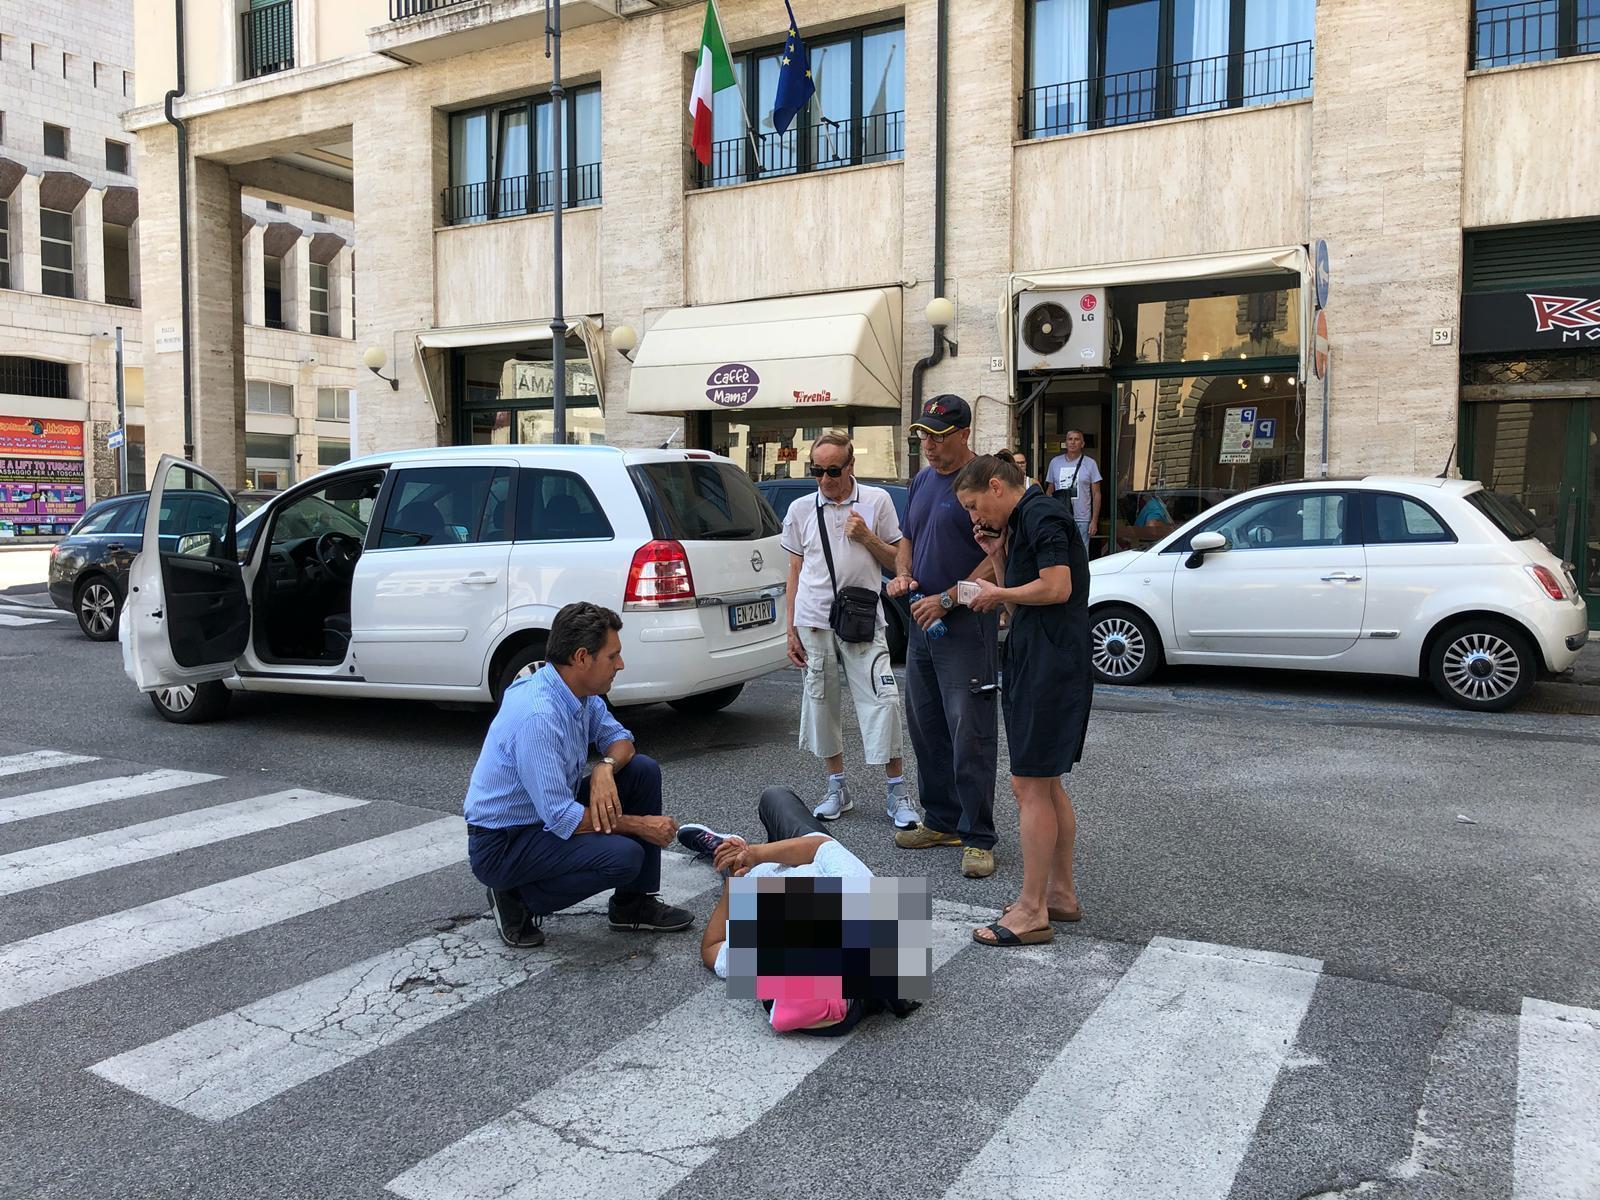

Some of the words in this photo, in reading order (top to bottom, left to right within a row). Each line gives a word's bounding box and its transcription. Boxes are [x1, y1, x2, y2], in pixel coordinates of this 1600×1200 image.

[1081, 314, 1095, 322] LG
[1434, 331, 1448, 341] 39
[992, 360, 1003, 368] 38
[713, 367, 750, 385] Caffè
[15, 460, 32, 470] LIFT
[34, 461, 46, 471] TO
[46, 462, 84, 472] TUSCANY
[0, 468, 32, 476] ASSAGGIO
[33, 469, 46, 477] PER
[57, 470, 84, 478] TOSCANA
[737, 607, 747, 624] EN
[748, 603, 771, 621] 241RV
